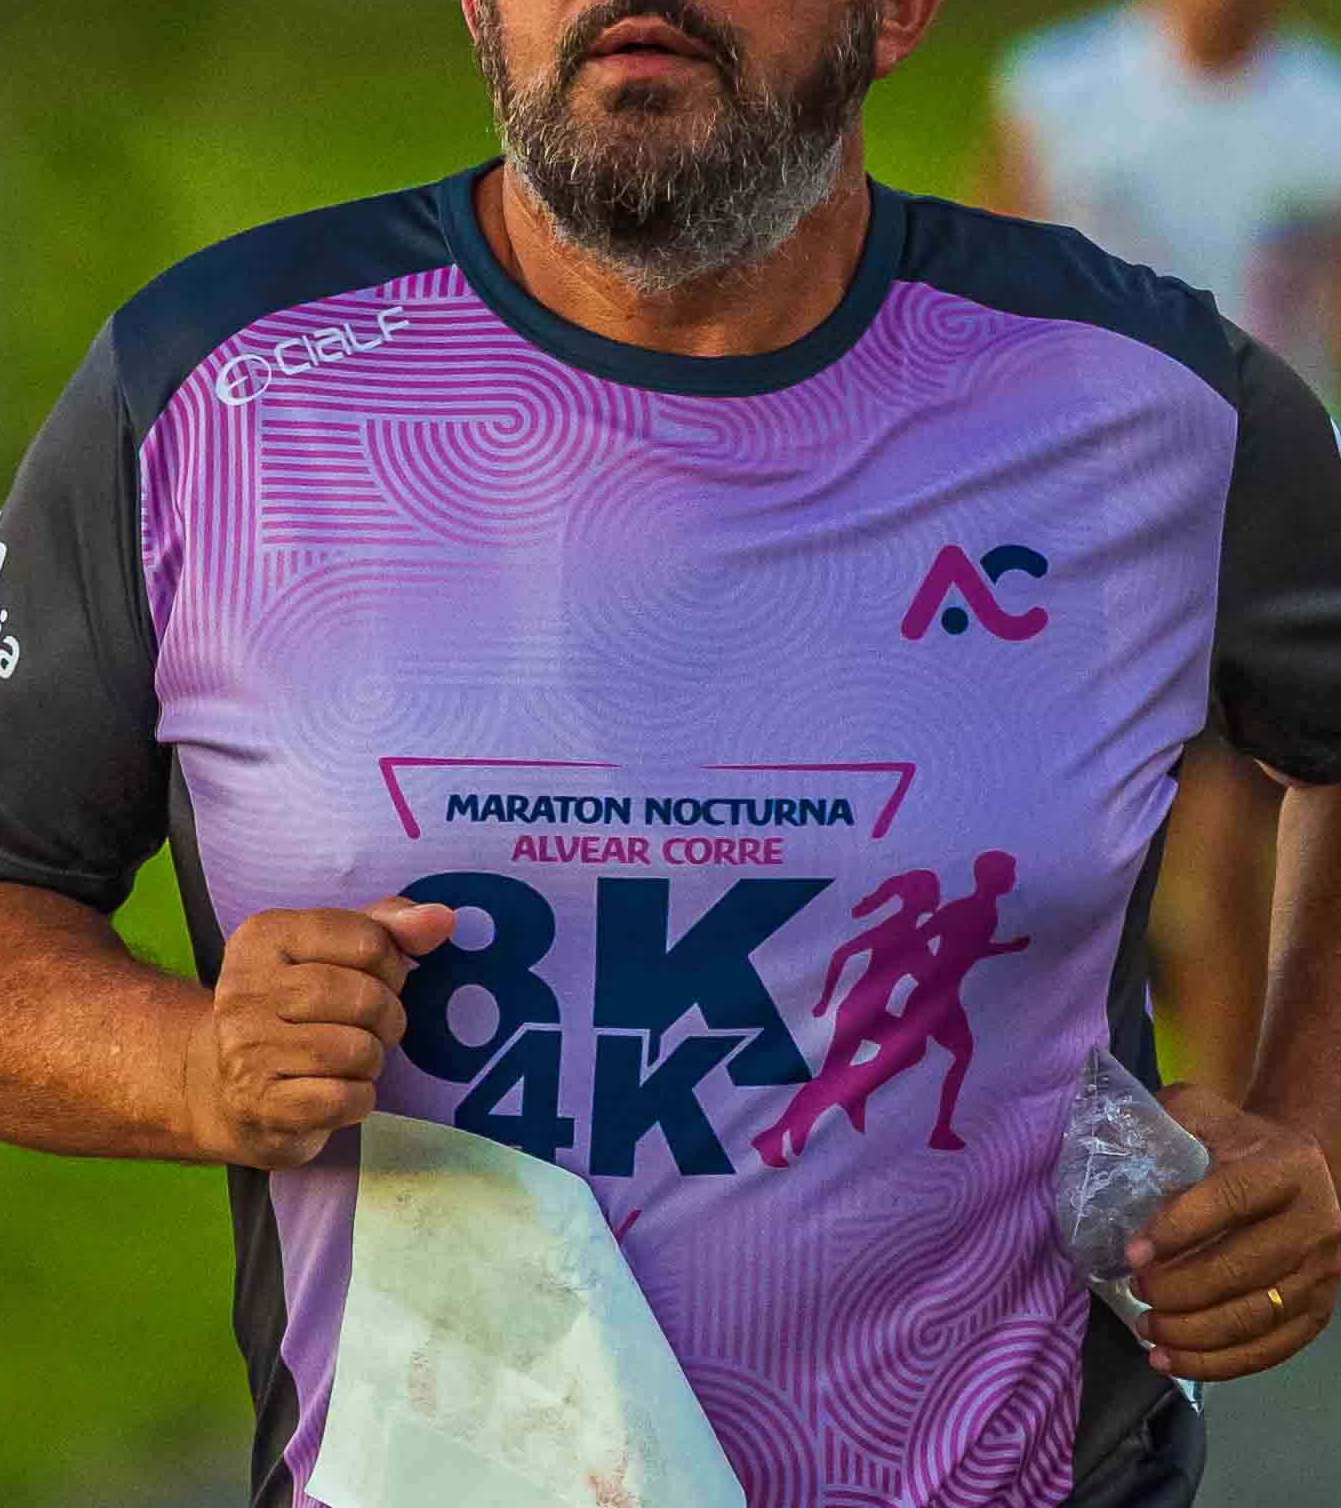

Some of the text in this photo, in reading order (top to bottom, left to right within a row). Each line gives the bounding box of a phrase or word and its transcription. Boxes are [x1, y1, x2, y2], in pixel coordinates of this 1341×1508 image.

[446, 793, 854, 827] MARATON NOCTURNA
[511, 834, 784, 866] ALVEAR CORRE
[398, 871, 835, 1088] 8K
[453, 1024, 736, 1177] 4K
